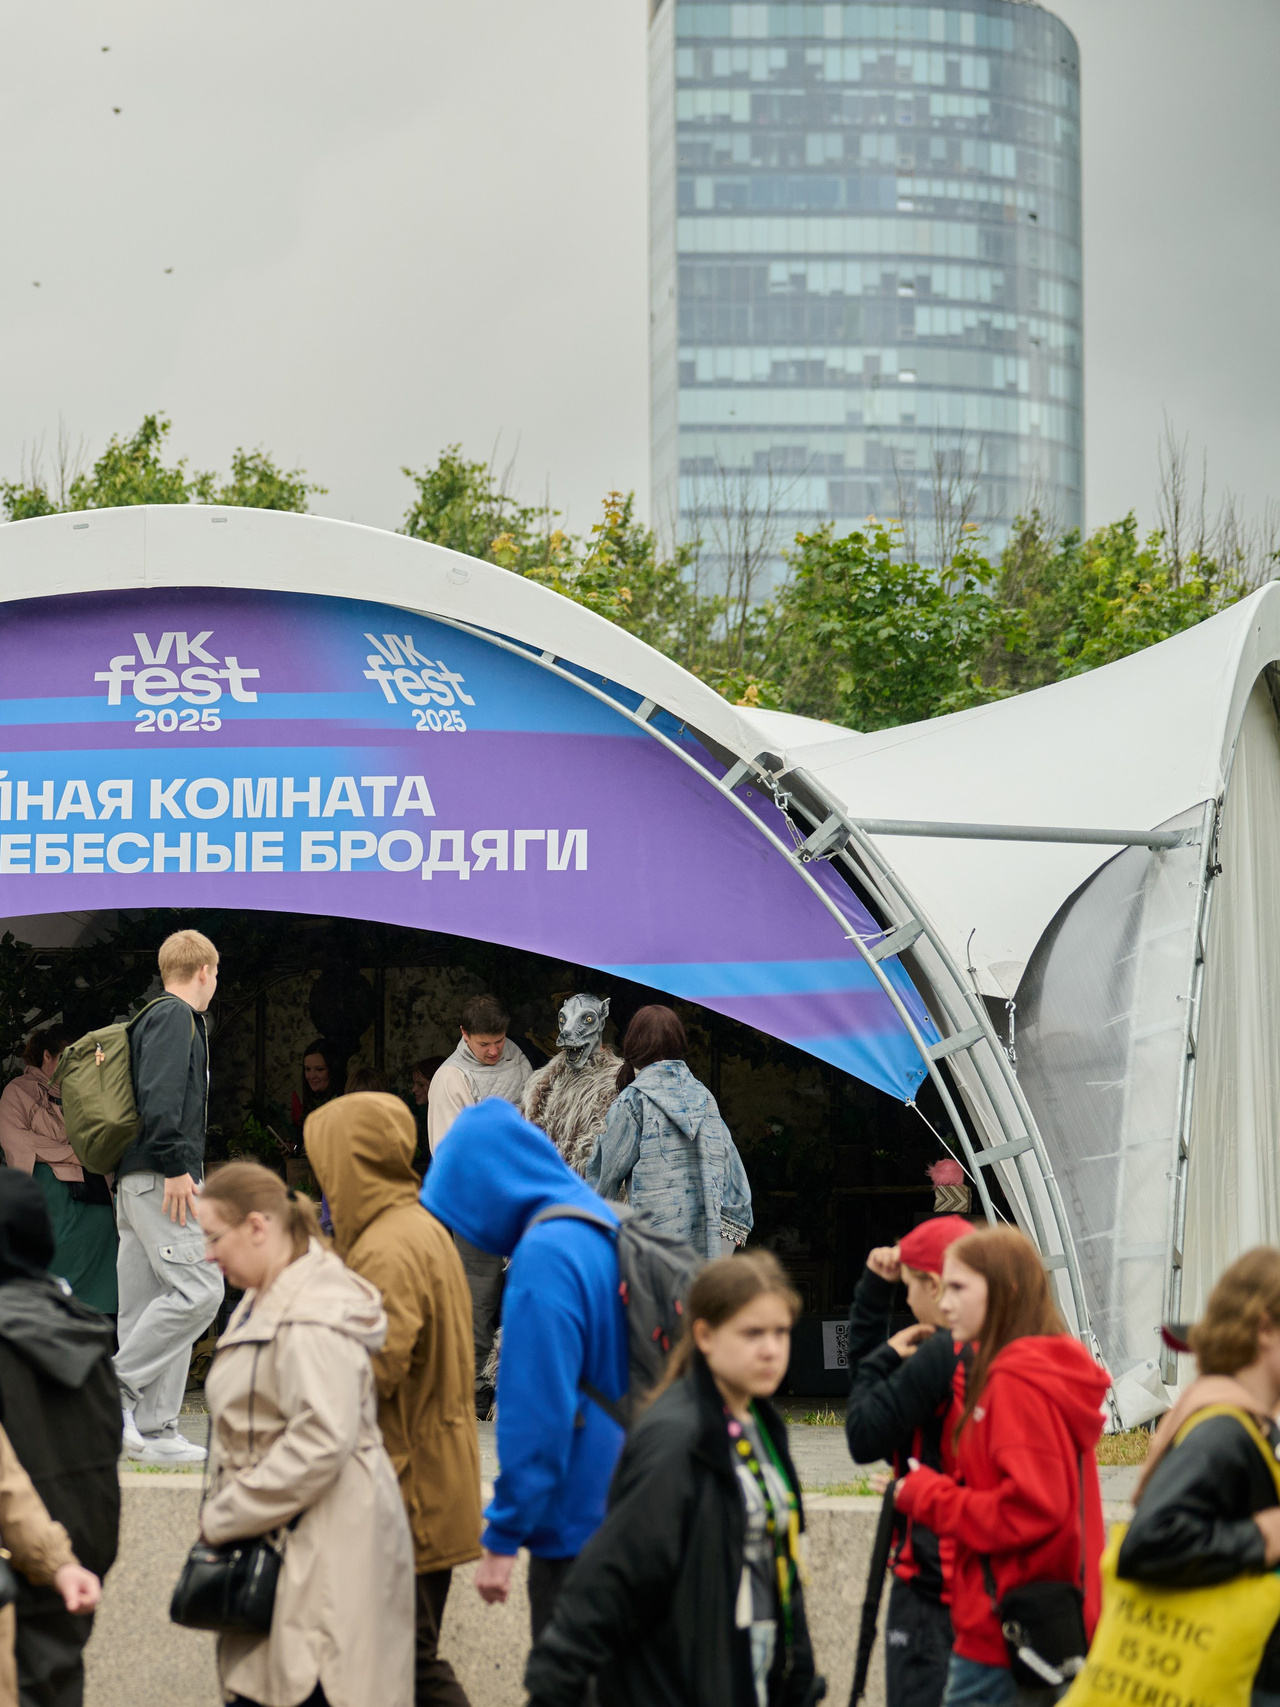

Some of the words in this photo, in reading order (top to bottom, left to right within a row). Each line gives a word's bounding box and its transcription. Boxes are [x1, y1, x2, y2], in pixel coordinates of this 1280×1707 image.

[132, 630, 221, 665] VK
[362, 633, 437, 667] VK
[94, 655, 261, 706] fest
[362, 654, 477, 707] fest
[134, 708, 222, 733] 2025
[411, 708, 467, 733] 2025
[149, 775, 437, 820] КОМНАТА
[300, 829, 589, 881] БРОДЯГИ
[1115, 1598, 1215, 1652] PLASTIC
[1117, 1636, 1140, 1664] IS
[1144, 1645, 1183, 1679] SO
